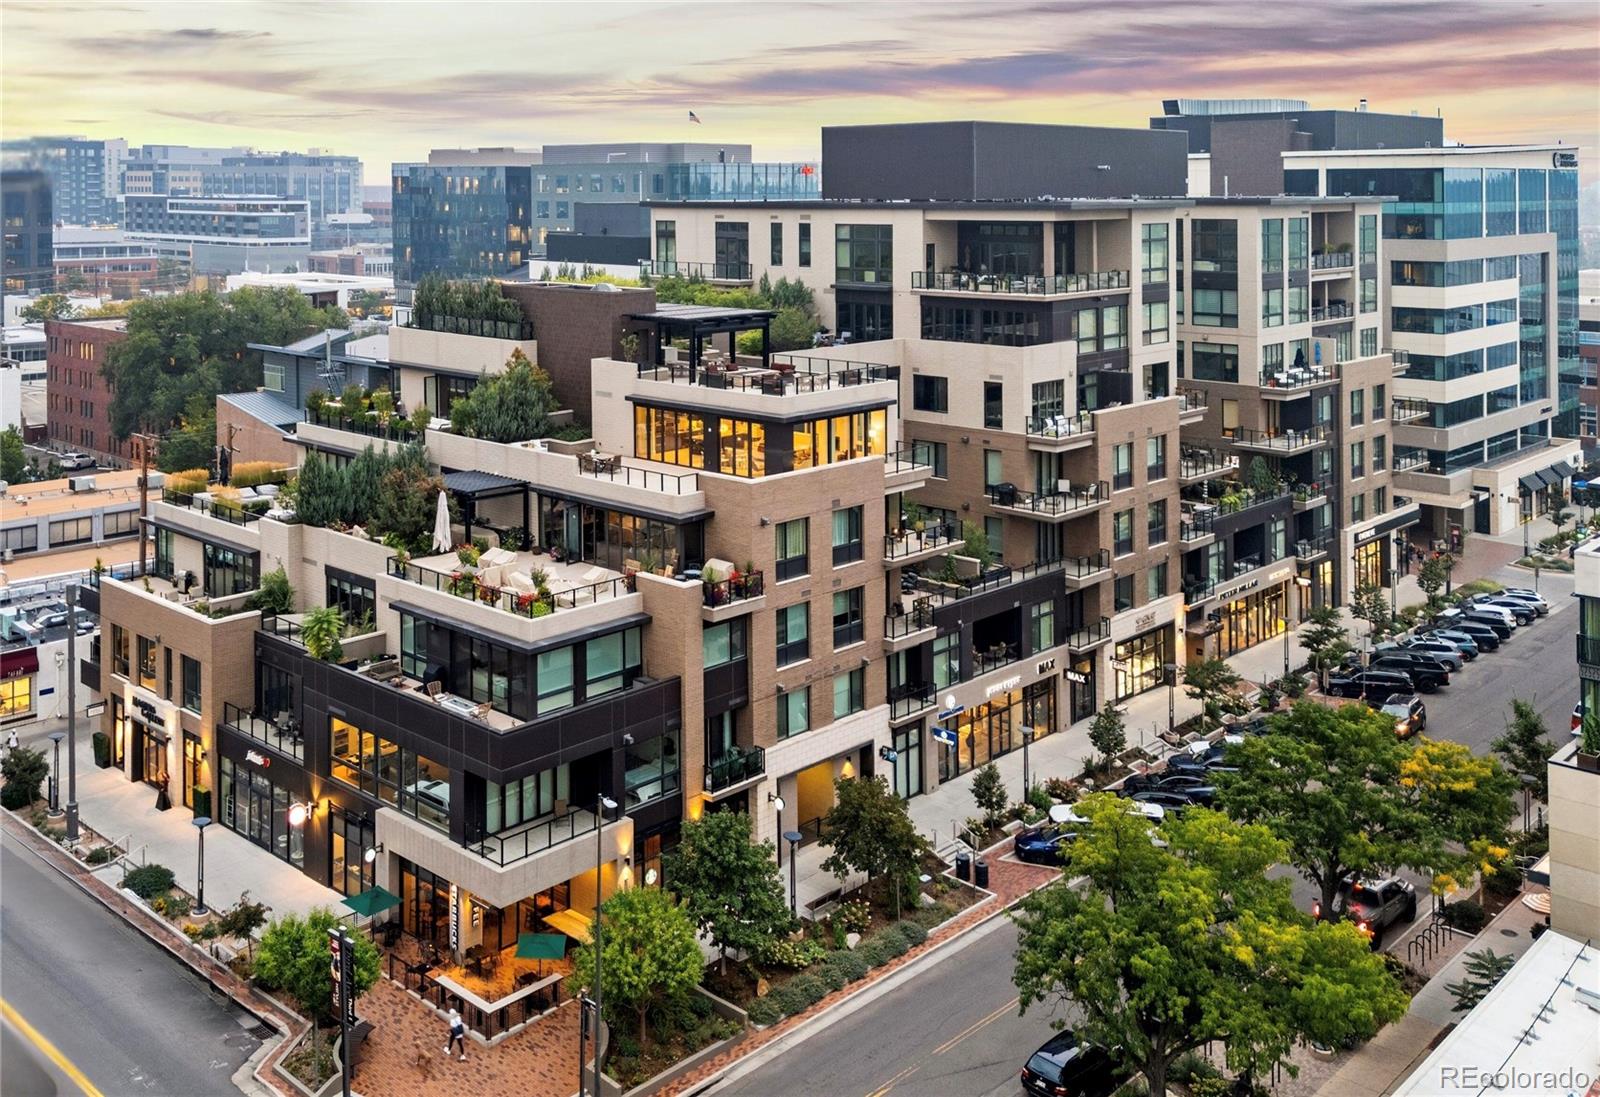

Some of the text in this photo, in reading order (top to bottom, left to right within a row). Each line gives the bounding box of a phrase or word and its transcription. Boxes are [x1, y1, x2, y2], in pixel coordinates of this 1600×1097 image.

[1037, 658, 1056, 675] MAX
[1066, 671, 1086, 684] MAX
[450, 885, 459, 951] STARBUCKS
